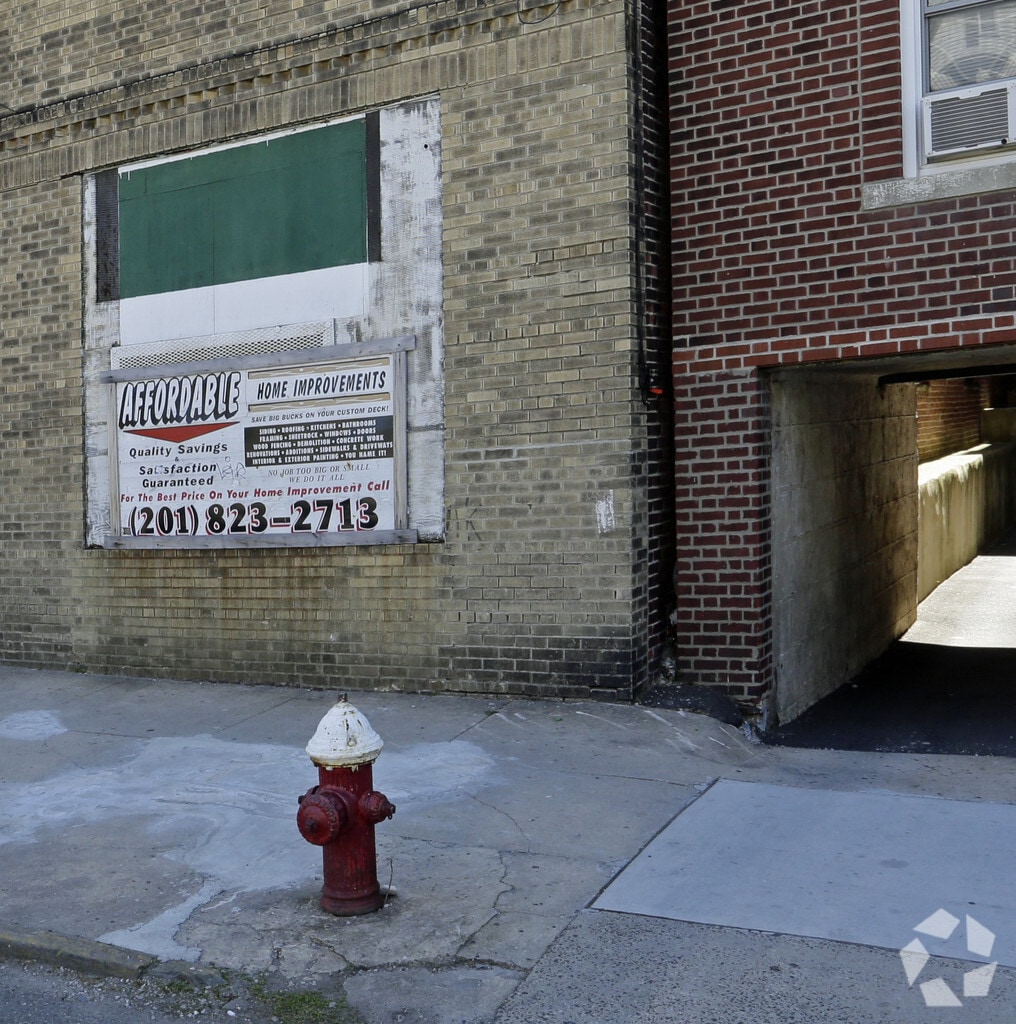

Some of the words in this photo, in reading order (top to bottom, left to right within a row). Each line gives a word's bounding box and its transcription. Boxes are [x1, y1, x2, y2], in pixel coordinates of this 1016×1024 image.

[257, 380, 288, 400] HOME
[293, 370, 386, 397] IMPROVEMENTS
[119, 371, 241, 429] AFFORDABLE
[317, 410, 335, 418] YOUR
[336, 407, 365, 416] CUSTOM
[368, 405, 389, 414] DECK!
[281, 425, 305, 433] ROOFING
[310, 423, 336, 431] KITCHENS
[342, 420, 376, 428] BATHROOMS
[288, 432, 318, 440] SHEETROCK
[357, 427, 376, 435] DOORS
[270, 441, 292, 449] FENCING
[297, 439, 330, 447] DEMOLITION
[336, 436, 364, 444] CONCRETE
[366, 434, 384, 442] WORK
[129, 446, 172, 459] Quality
[177, 442, 228, 454] Savings
[246, 450, 280, 458] RENOVATIONS
[285, 447, 314, 455] ADDITIONS
[319, 445, 350, 453] SIDEWALKS
[360, 442, 393, 450] DRIVEWAYS
[252, 457, 276, 465] INTERIOR
[284, 455, 311, 463] EXTERIOR
[313, 453, 339, 461] PAINTING
[358, 450, 376, 458] NAME
[280, 468, 294, 477] JOB
[296, 467, 311, 475] TOO
[314, 466, 327, 474] BIG
[142, 476, 214, 488] Guaranteed
[120, 494, 134, 503] For
[138, 493, 153, 502] The
[157, 493, 177, 501] Best
[181, 491, 205, 501] Price
[209, 490, 222, 499] On
[227, 489, 249, 499] Your
[253, 488, 282, 497] Home
[287, 483, 362, 497] Improvement
[367, 480, 390, 491] Call
[128, 504, 199, 536] (201)
[206, 497, 379, 535] 823-2713
